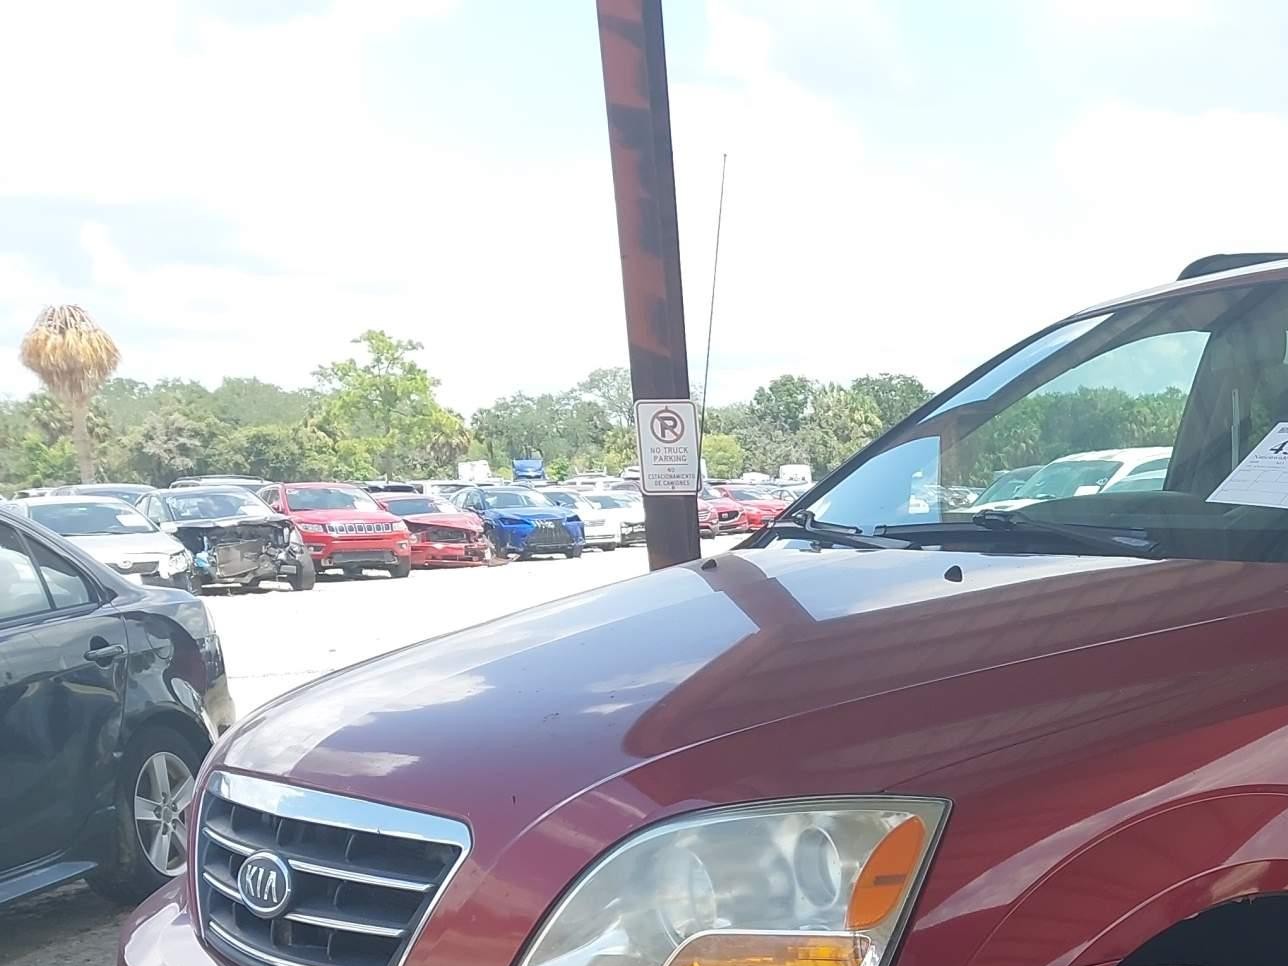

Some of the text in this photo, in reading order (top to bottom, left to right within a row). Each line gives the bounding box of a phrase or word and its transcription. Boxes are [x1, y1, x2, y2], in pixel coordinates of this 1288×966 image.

[664, 446, 689, 454] TRUCK
[653, 455, 688, 463] PARKING
[245, 864, 278, 903] KIA
